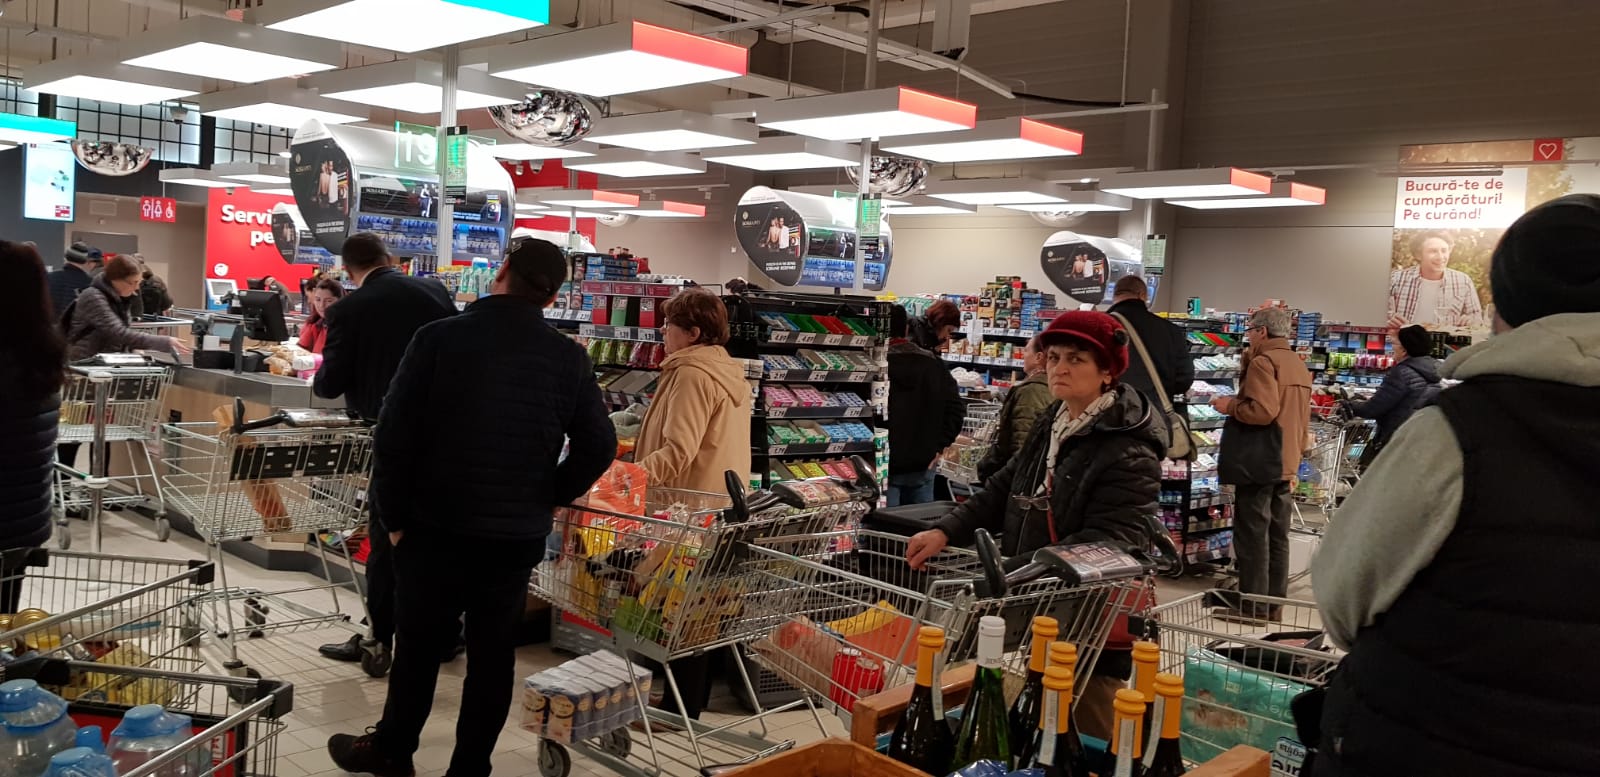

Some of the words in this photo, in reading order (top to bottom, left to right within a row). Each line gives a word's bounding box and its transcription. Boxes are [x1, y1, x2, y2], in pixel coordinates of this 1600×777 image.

[401, 131, 436, 165] 19
[1405, 179, 1479, 192] Bucură-te
[1484, 178, 1504, 190] de
[1404, 193, 1503, 208] cumpărături!
[221, 204, 273, 224] Servi
[1403, 209, 1421, 220] Pe
[250, 230, 275, 247] pe
